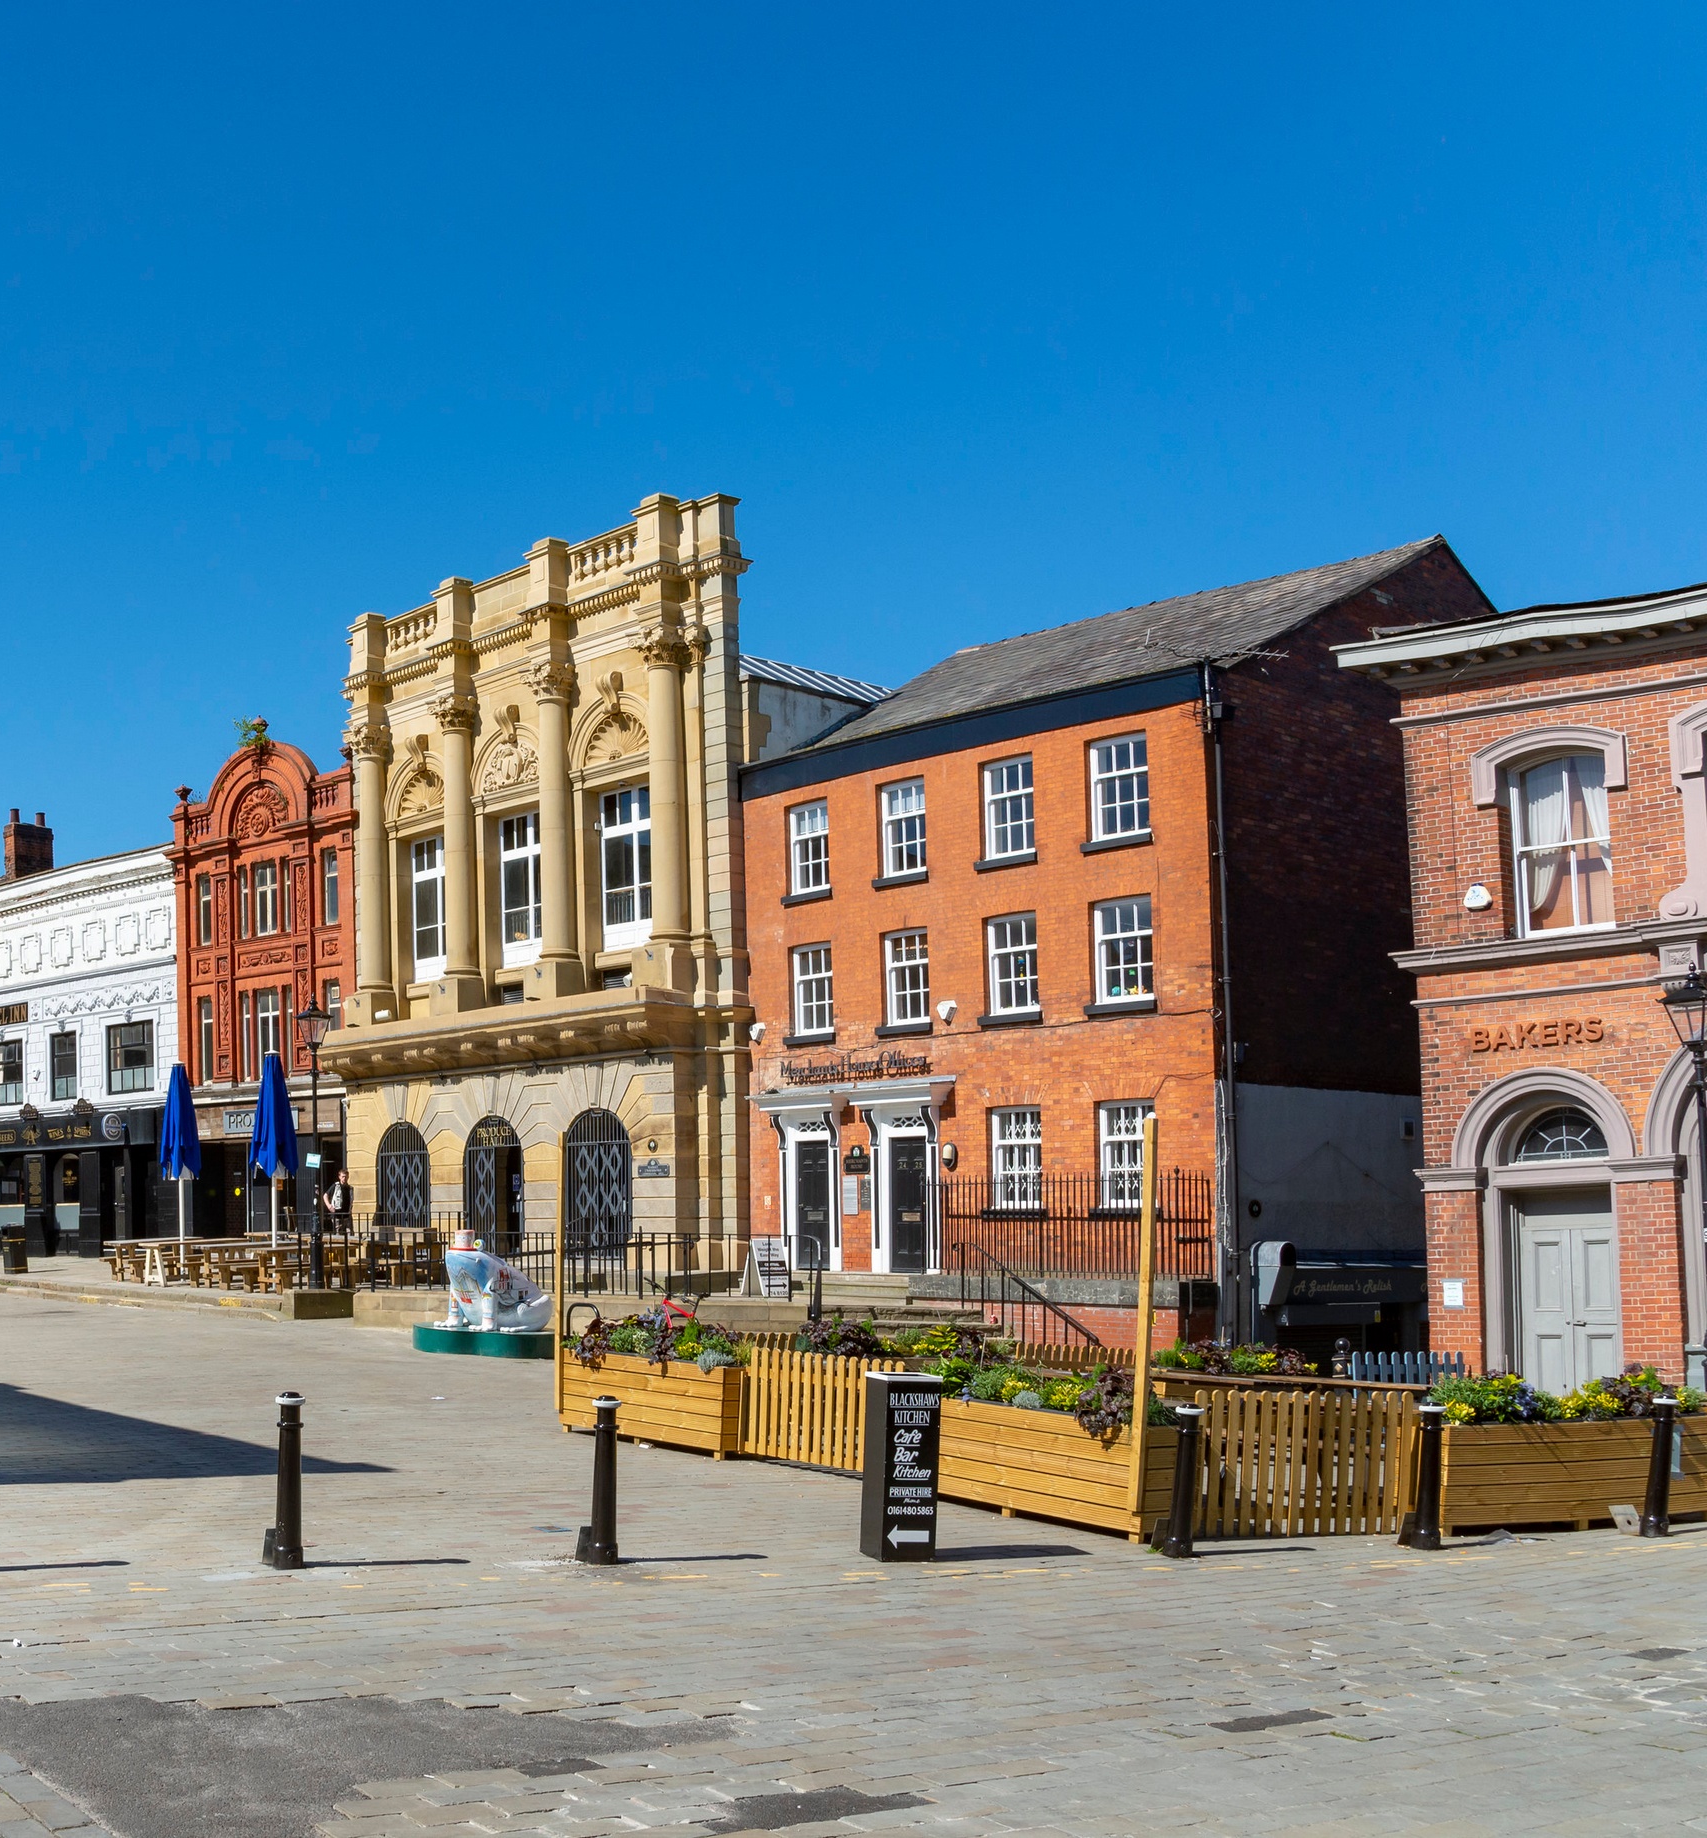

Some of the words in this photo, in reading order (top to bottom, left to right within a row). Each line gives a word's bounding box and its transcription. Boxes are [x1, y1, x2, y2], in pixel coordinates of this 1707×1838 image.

[10, 1004, 27, 1023] INN
[1470, 1017, 1603, 1053] BAKERS
[780, 1058, 837, 1078] Merchants
[840, 1052, 879, 1073] House
[879, 1050, 927, 1069] Offices
[477, 1127, 511, 1138] PRODUCE
[483, 1136, 505, 1147] HALL
[1363, 1279, 1392, 1294] Relish
[889, 1393, 940, 1407] BLACKSHAWS
[894, 1410, 930, 1424] KITCHEN
[894, 1428, 922, 1444] Cafe
[894, 1447, 919, 1462] Bar
[893, 1465, 932, 1478] Kitchen
[889, 1487, 916, 1497] PRIVATE
[917, 1487, 932, 1497] HIRE
